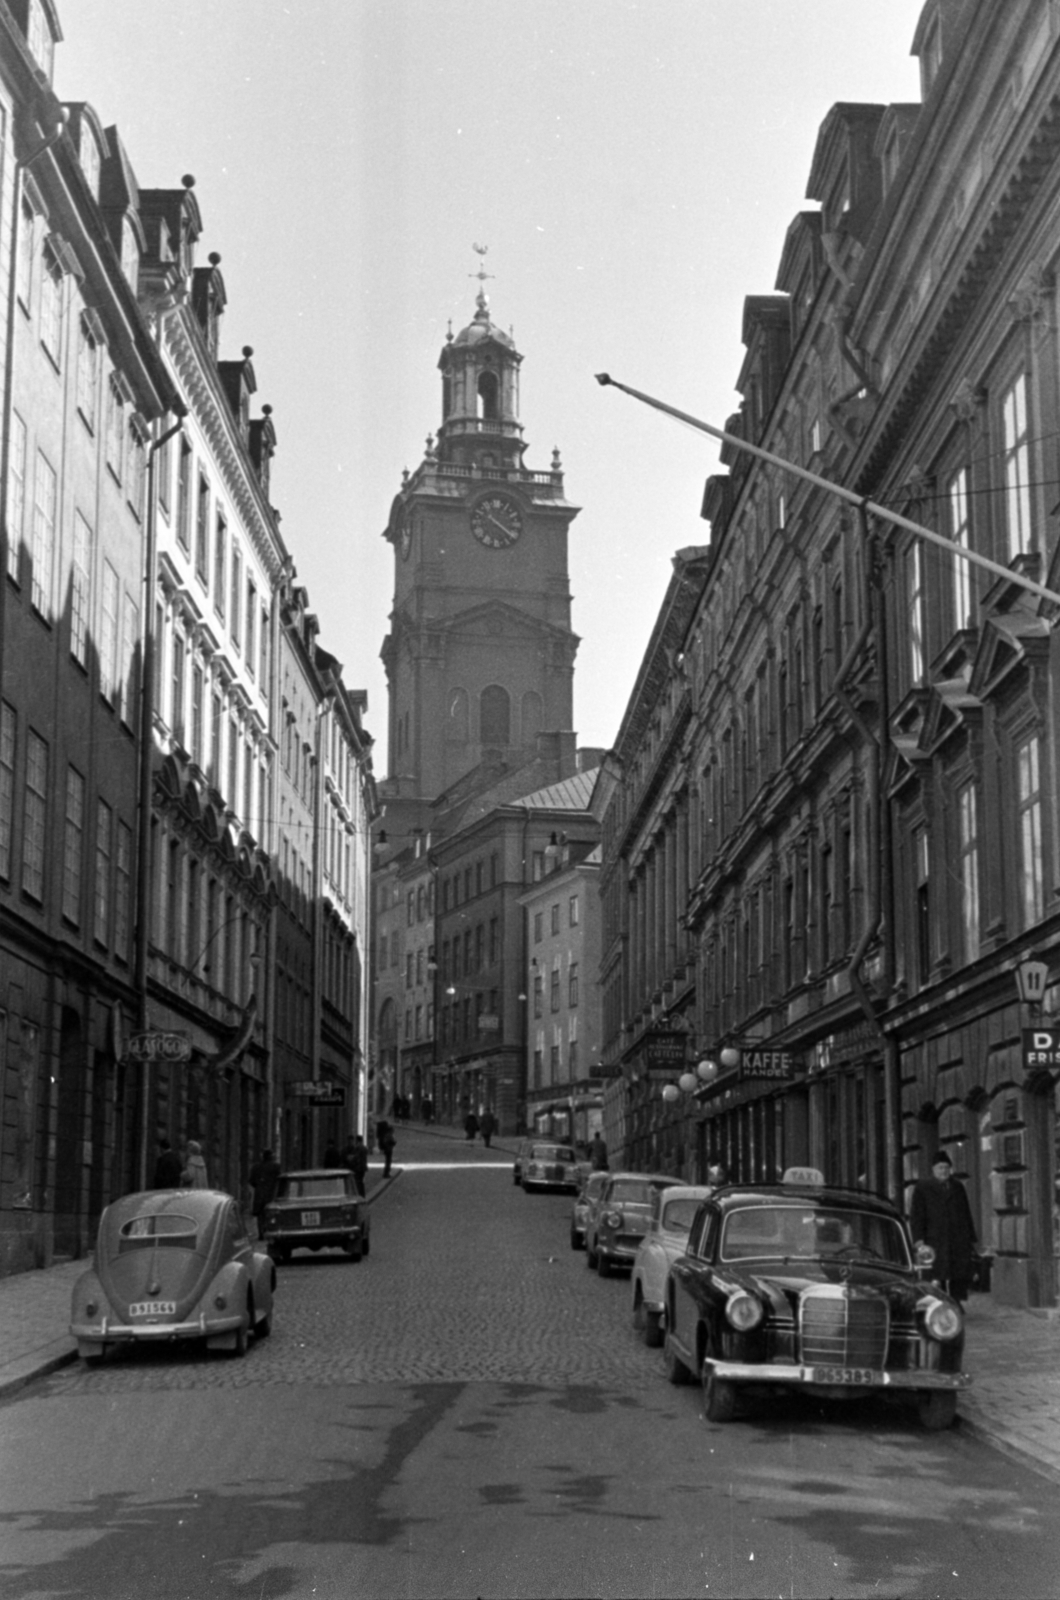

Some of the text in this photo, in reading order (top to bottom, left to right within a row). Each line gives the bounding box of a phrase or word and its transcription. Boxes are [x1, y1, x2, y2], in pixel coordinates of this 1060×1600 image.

[1033, 1033, 1060, 1049] D
[743, 1069, 789, 1077] HANDEL
[790, 1171, 819, 1181] TAXI
